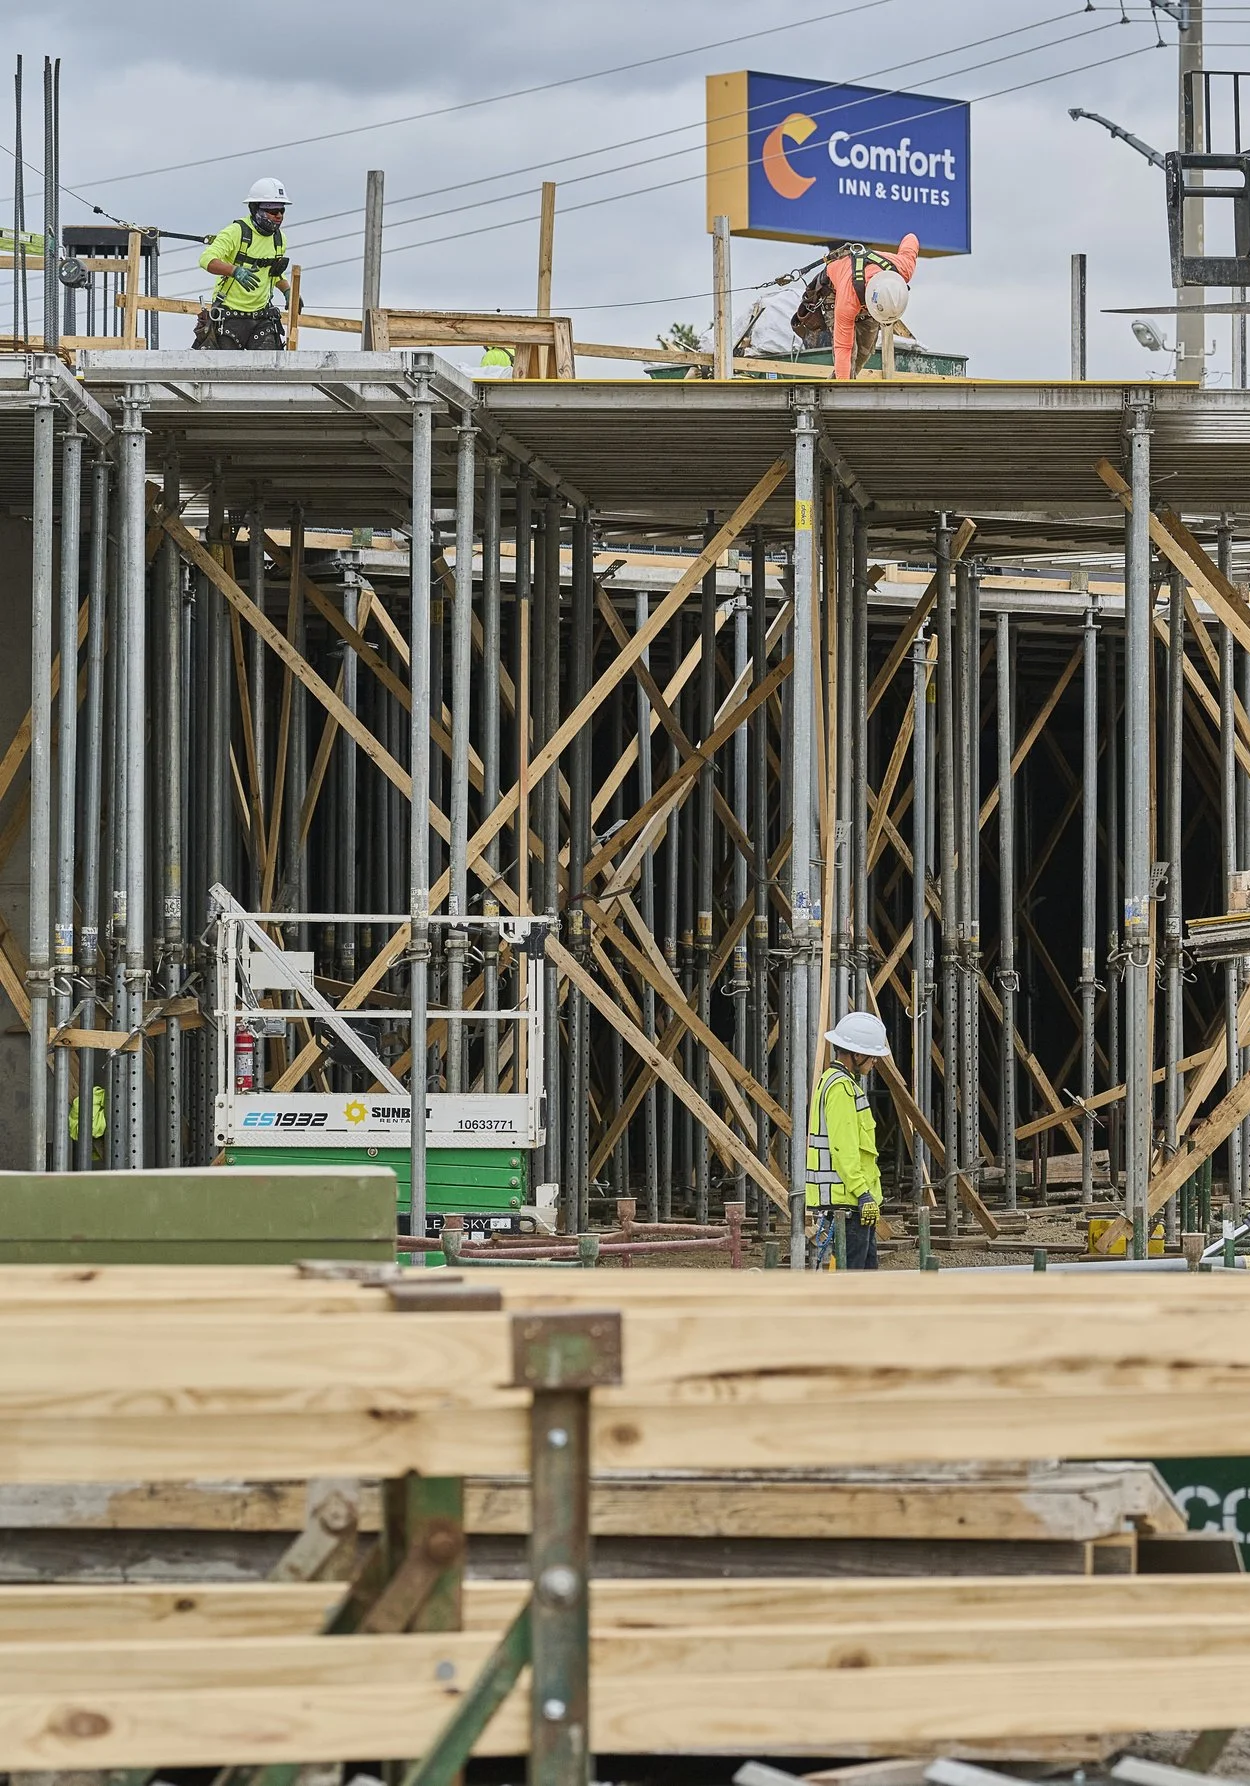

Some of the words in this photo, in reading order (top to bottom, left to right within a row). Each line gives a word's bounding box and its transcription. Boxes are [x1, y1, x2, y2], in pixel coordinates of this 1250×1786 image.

[828, 130, 956, 181] Comfort
[838, 177, 871, 199] INN
[875, 183, 887, 199] &
[891, 184, 950, 206] SUITES
[242, 1112, 329, 1127] ES1932
[371, 1106, 433, 1119] SUNBT
[457, 1119, 514, 1130] 10633771
